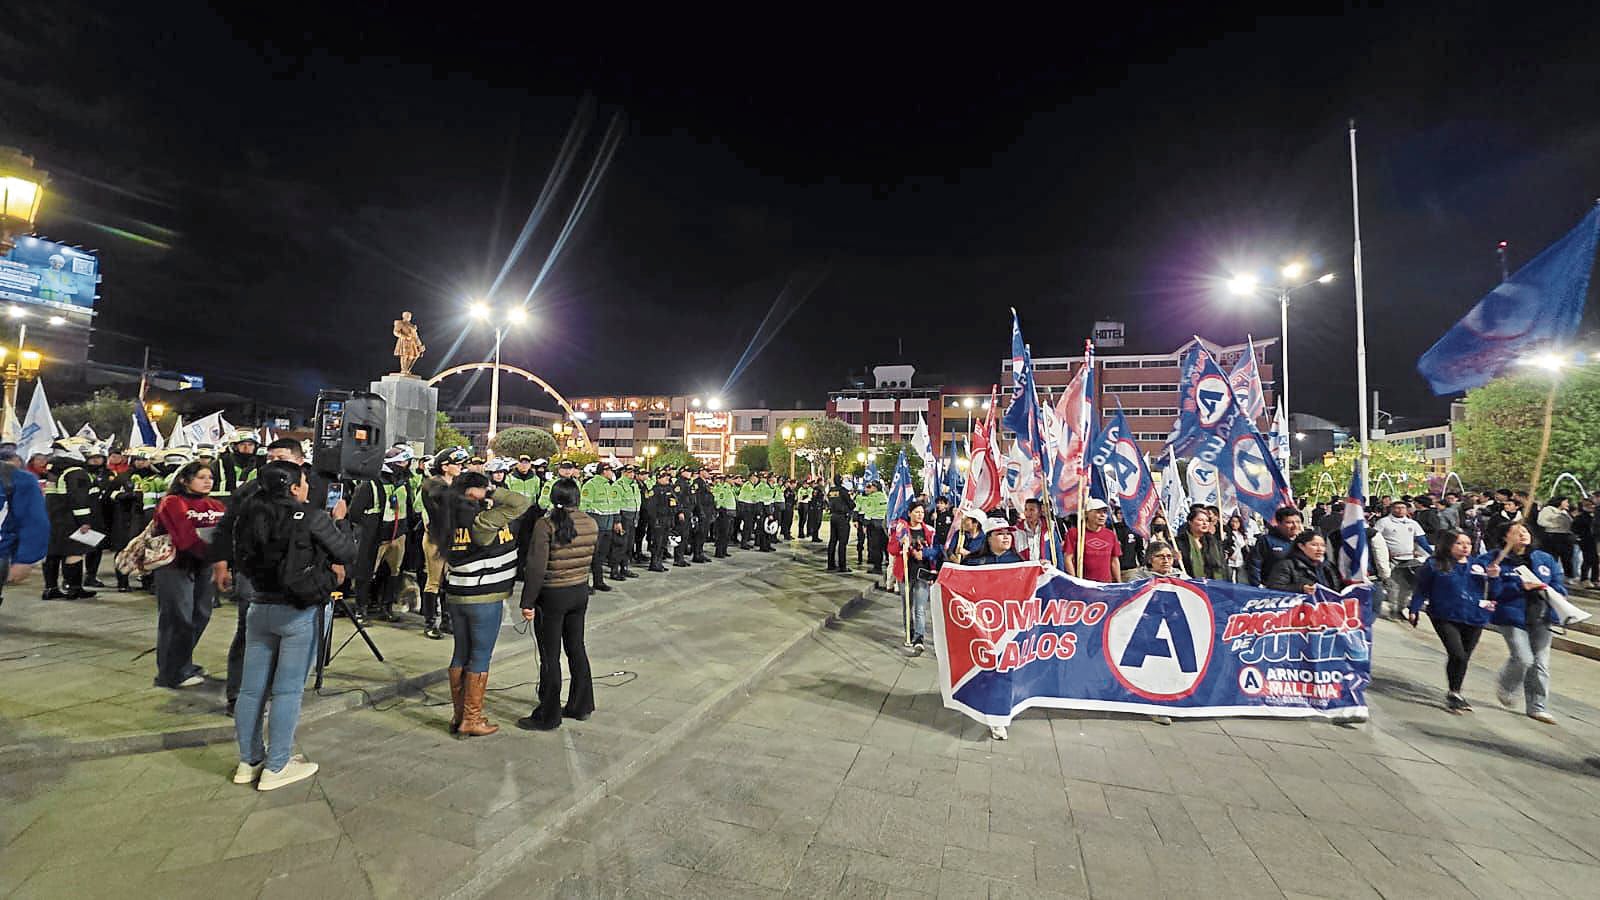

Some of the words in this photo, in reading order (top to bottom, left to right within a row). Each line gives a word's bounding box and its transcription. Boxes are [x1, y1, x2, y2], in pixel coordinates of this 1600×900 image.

[1095, 329, 1124, 339] HOTEL
[1119, 589, 1199, 673] A
[1231, 637, 1254, 652] DE
[1243, 670, 1260, 688] A
[1265, 667, 1344, 685] ARNOLDO
